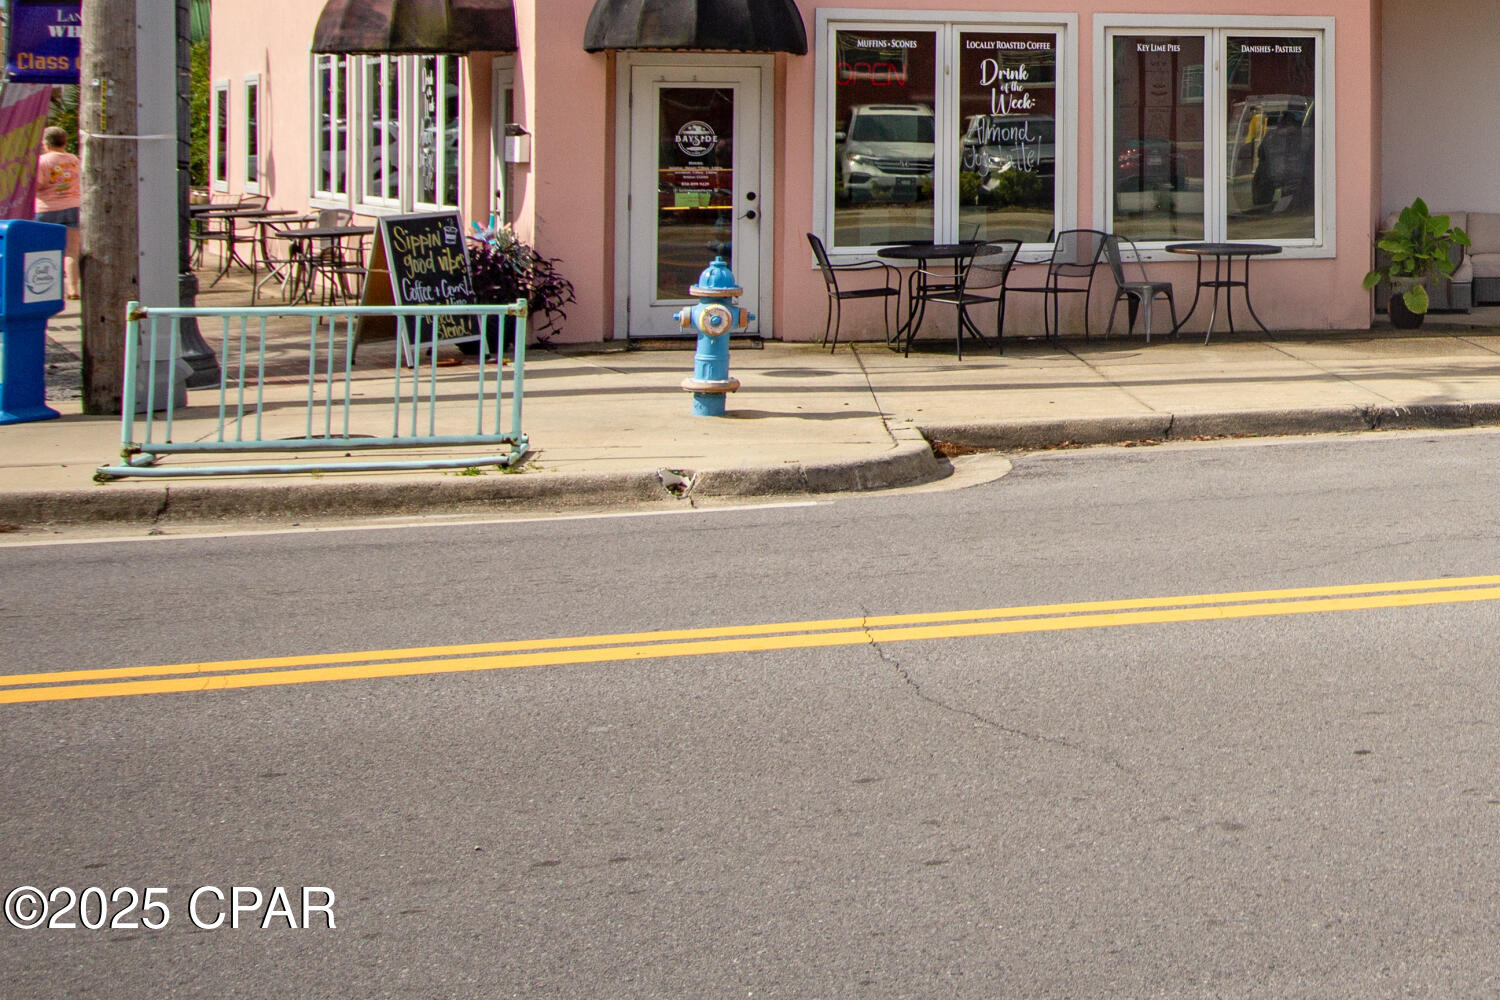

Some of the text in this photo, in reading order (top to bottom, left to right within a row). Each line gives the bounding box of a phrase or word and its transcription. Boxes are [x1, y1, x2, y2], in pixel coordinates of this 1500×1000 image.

[856, 39, 918, 48] MUFFINS SCONES
[966, 40, 1051, 50] LOCALLY ROASTED COFFEE
[1136, 43, 1181, 52] KEY LIME PIES
[1240, 44, 1302, 53] DANISHES PASTRIES
[17, 52, 70, 70] Class
[836, 62, 906, 87] OPEN
[980, 58, 1029, 86] Drink
[1000, 81, 1025, 94] of the
[991, 87, 1036, 115] Week:
[968, 115, 1035, 144] Almond
[675, 135, 718, 146] BAYSIDE
[393, 222, 441, 257] Sippin'
[404, 251, 436, 279] good
[402, 278, 434, 303] Coffee
